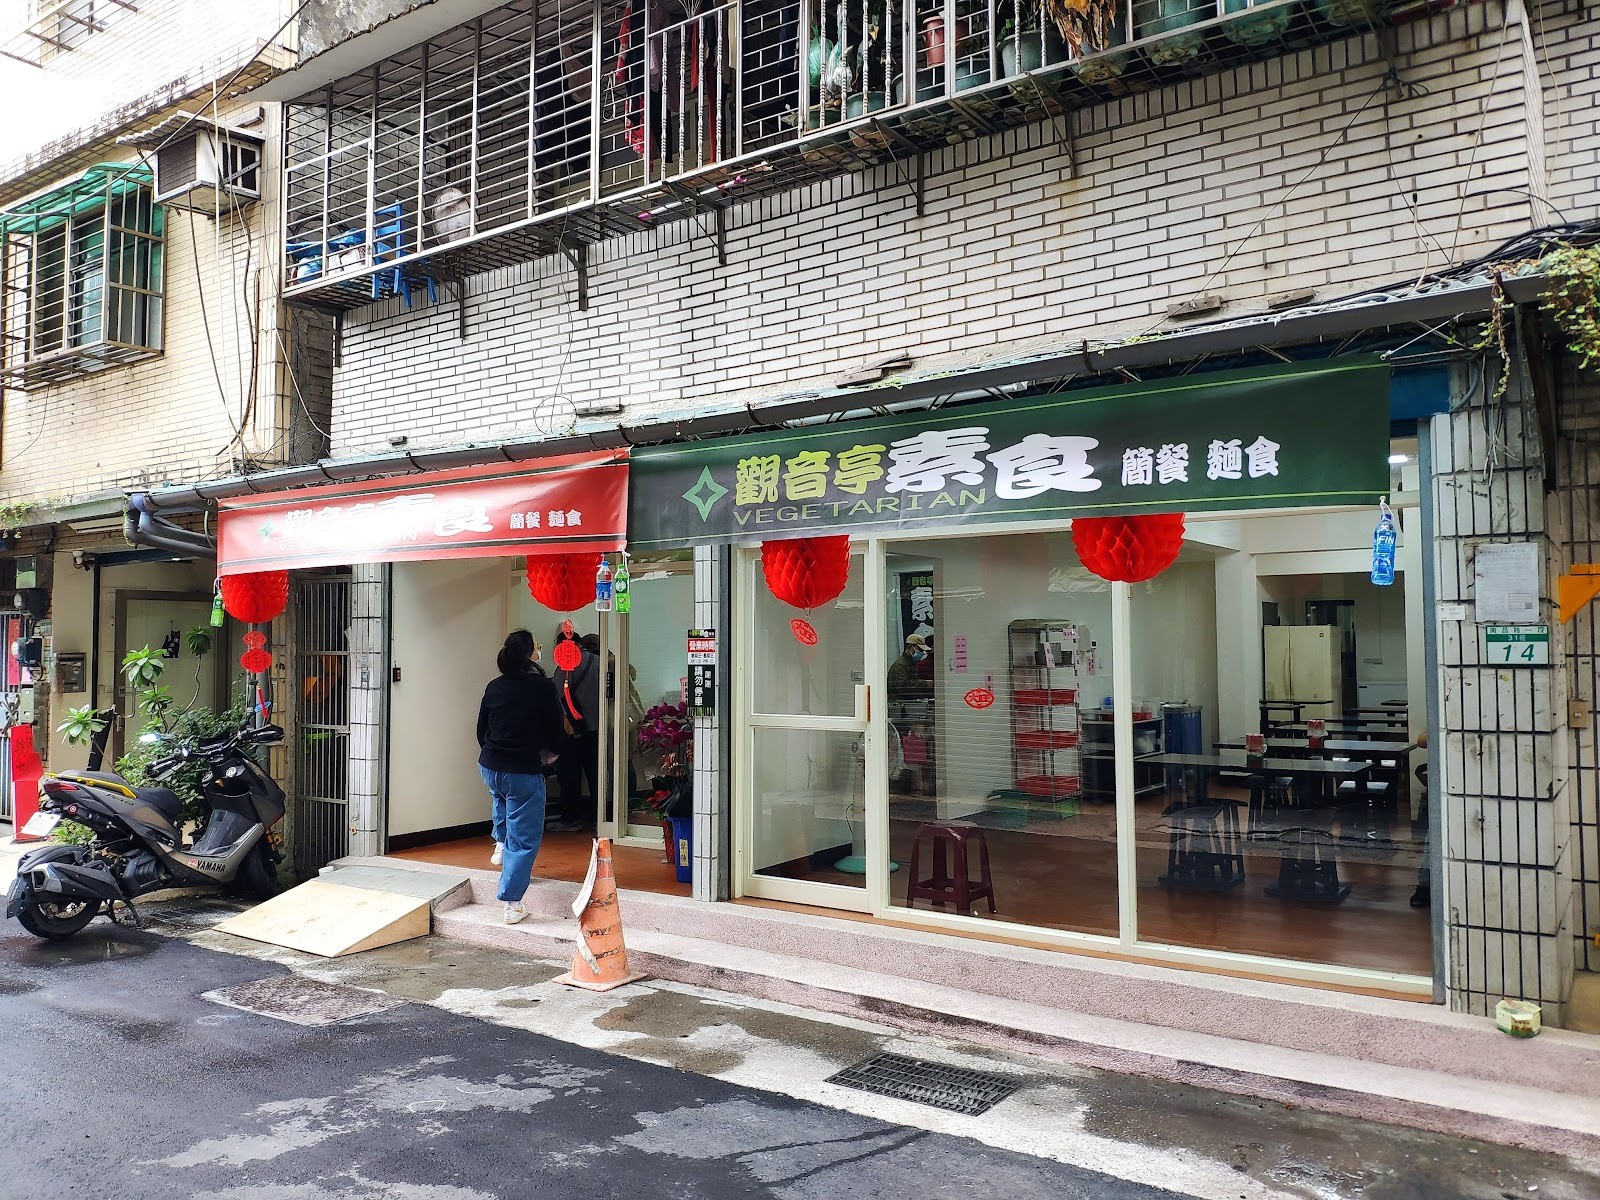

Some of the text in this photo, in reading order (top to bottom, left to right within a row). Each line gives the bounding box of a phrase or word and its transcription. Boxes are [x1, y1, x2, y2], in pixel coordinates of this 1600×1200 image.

[1121, 442, 1189, 487] 簡餐
[1206, 435, 1281, 481] 麵食
[734, 488, 987, 526] VEGETARIAN
[510, 511, 541, 530] 簡餐
[548, 508, 582, 528] 麵食
[1379, 535, 1395, 545] FIN
[1503, 643, 1535, 662] 14
[694, 665, 704, 707] 請勿停車
[197, 860, 226, 873] YAMAHA
